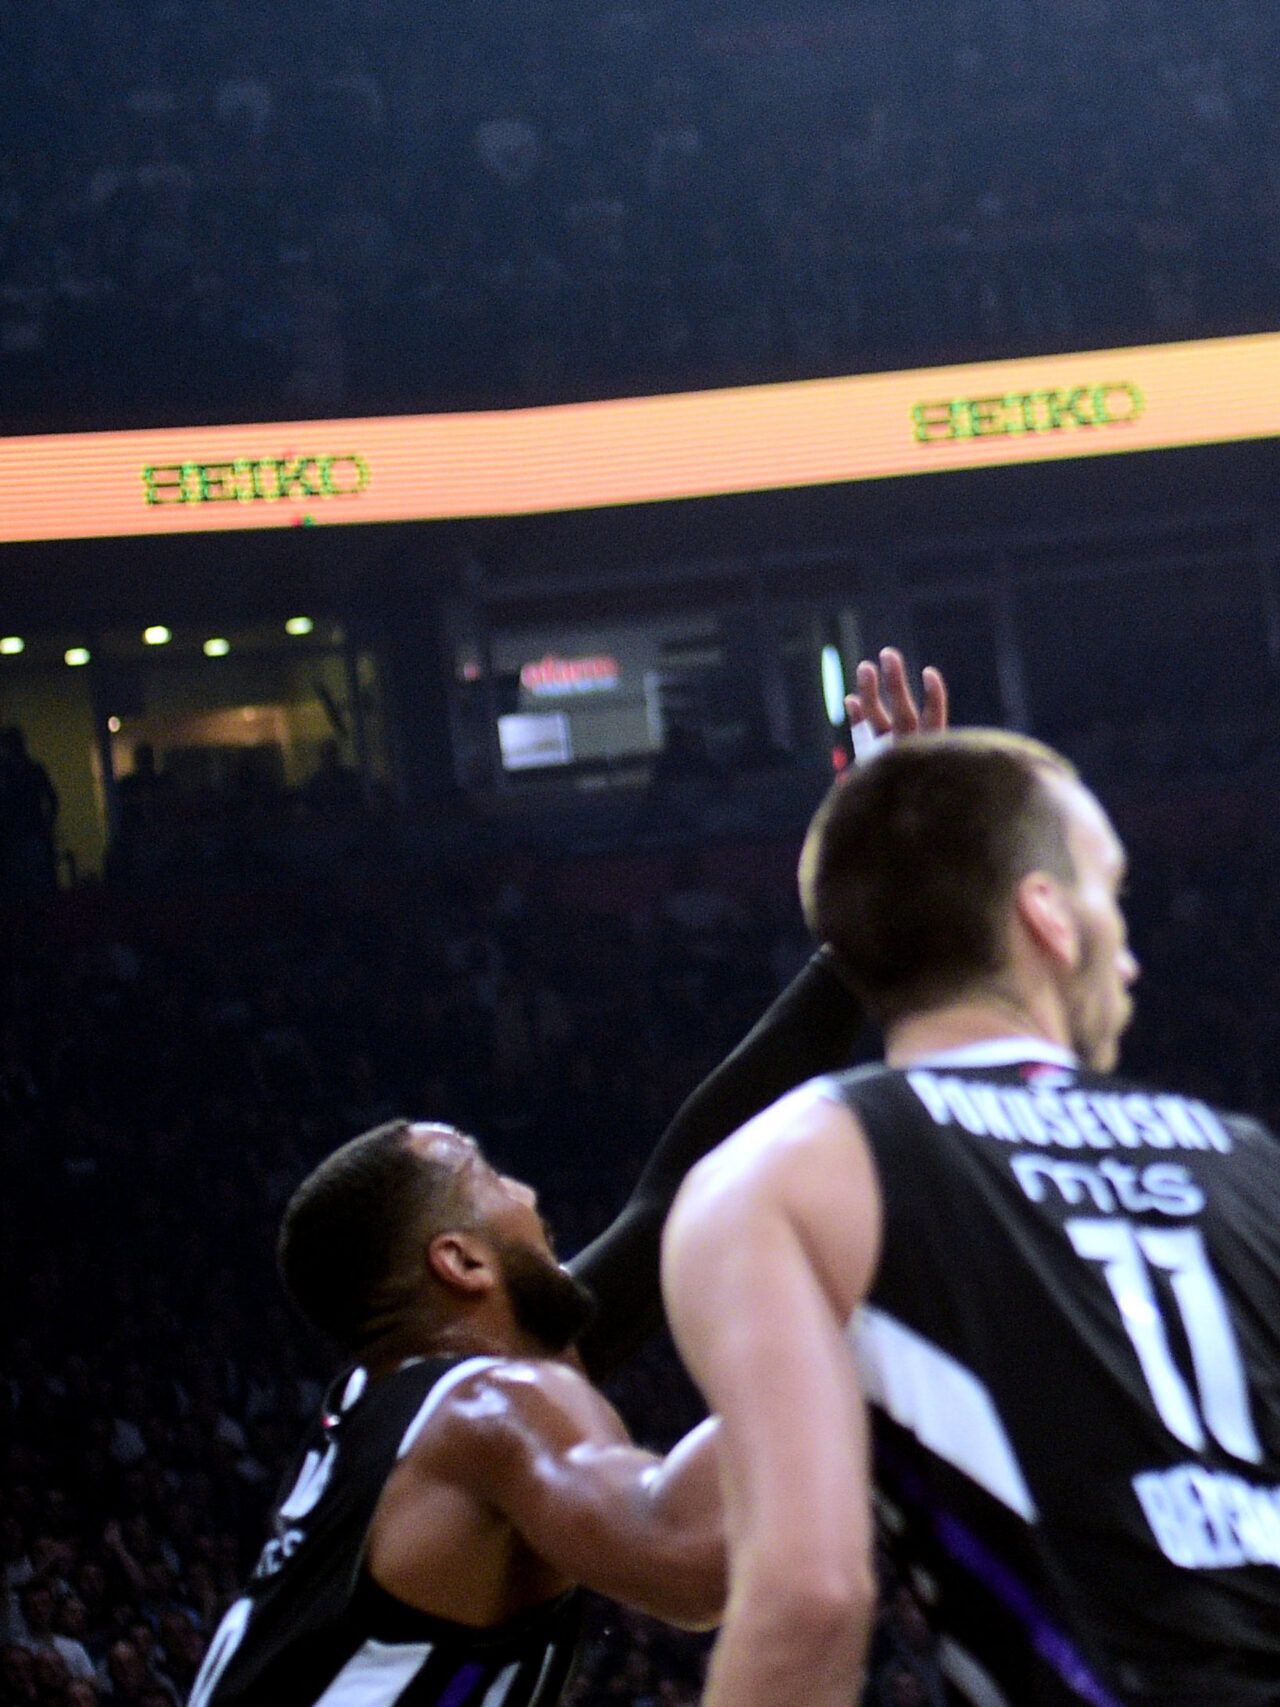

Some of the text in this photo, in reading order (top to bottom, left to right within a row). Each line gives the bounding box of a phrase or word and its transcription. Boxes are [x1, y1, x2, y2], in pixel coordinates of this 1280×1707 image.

[911, 379, 1145, 443] SEIKO
[143, 456, 368, 504] SEIKO
[1010, 1151, 1205, 1217] mts
